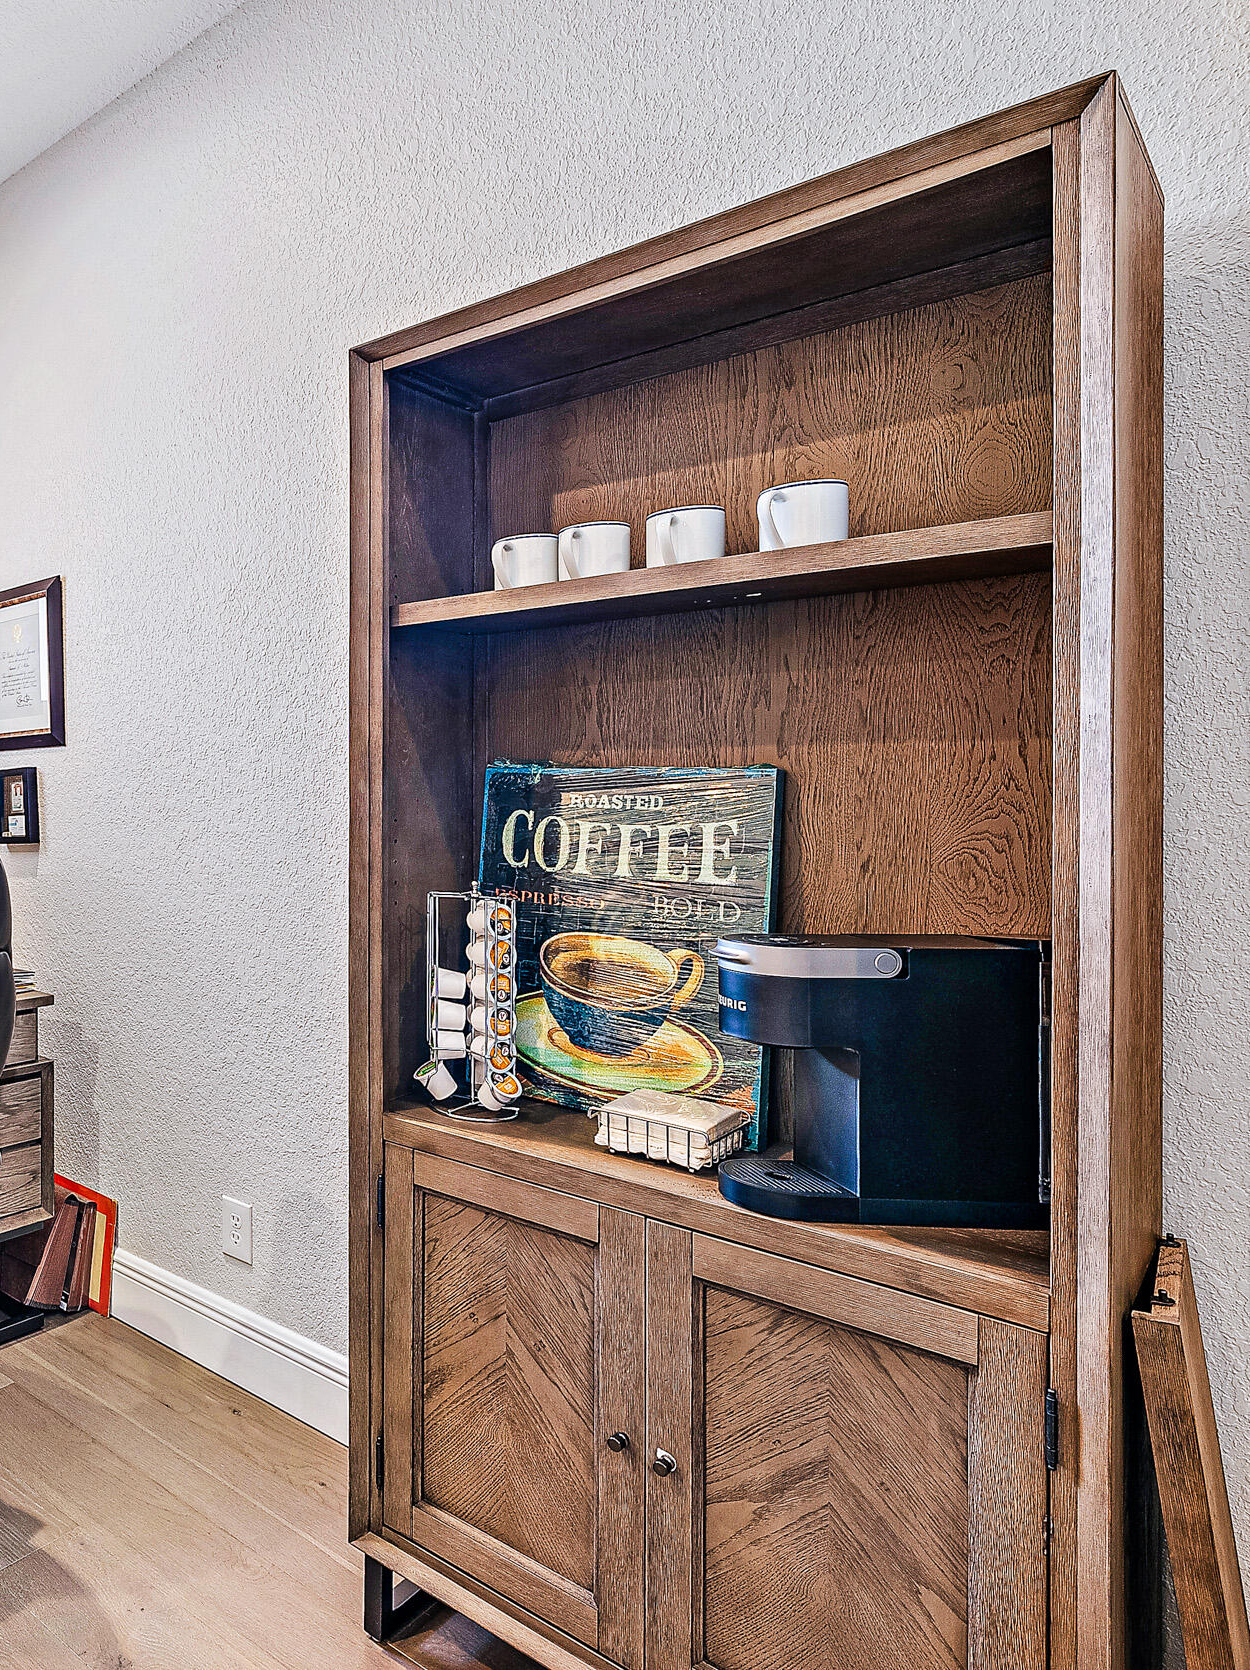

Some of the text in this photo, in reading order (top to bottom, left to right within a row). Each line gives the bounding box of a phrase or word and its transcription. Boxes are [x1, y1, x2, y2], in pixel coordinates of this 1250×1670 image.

[569, 793, 664, 811] ROASTED
[501, 809, 740, 885] COFFEE
[652, 895, 741, 922] BOLD
[718, 994, 747, 1012] EURIG
